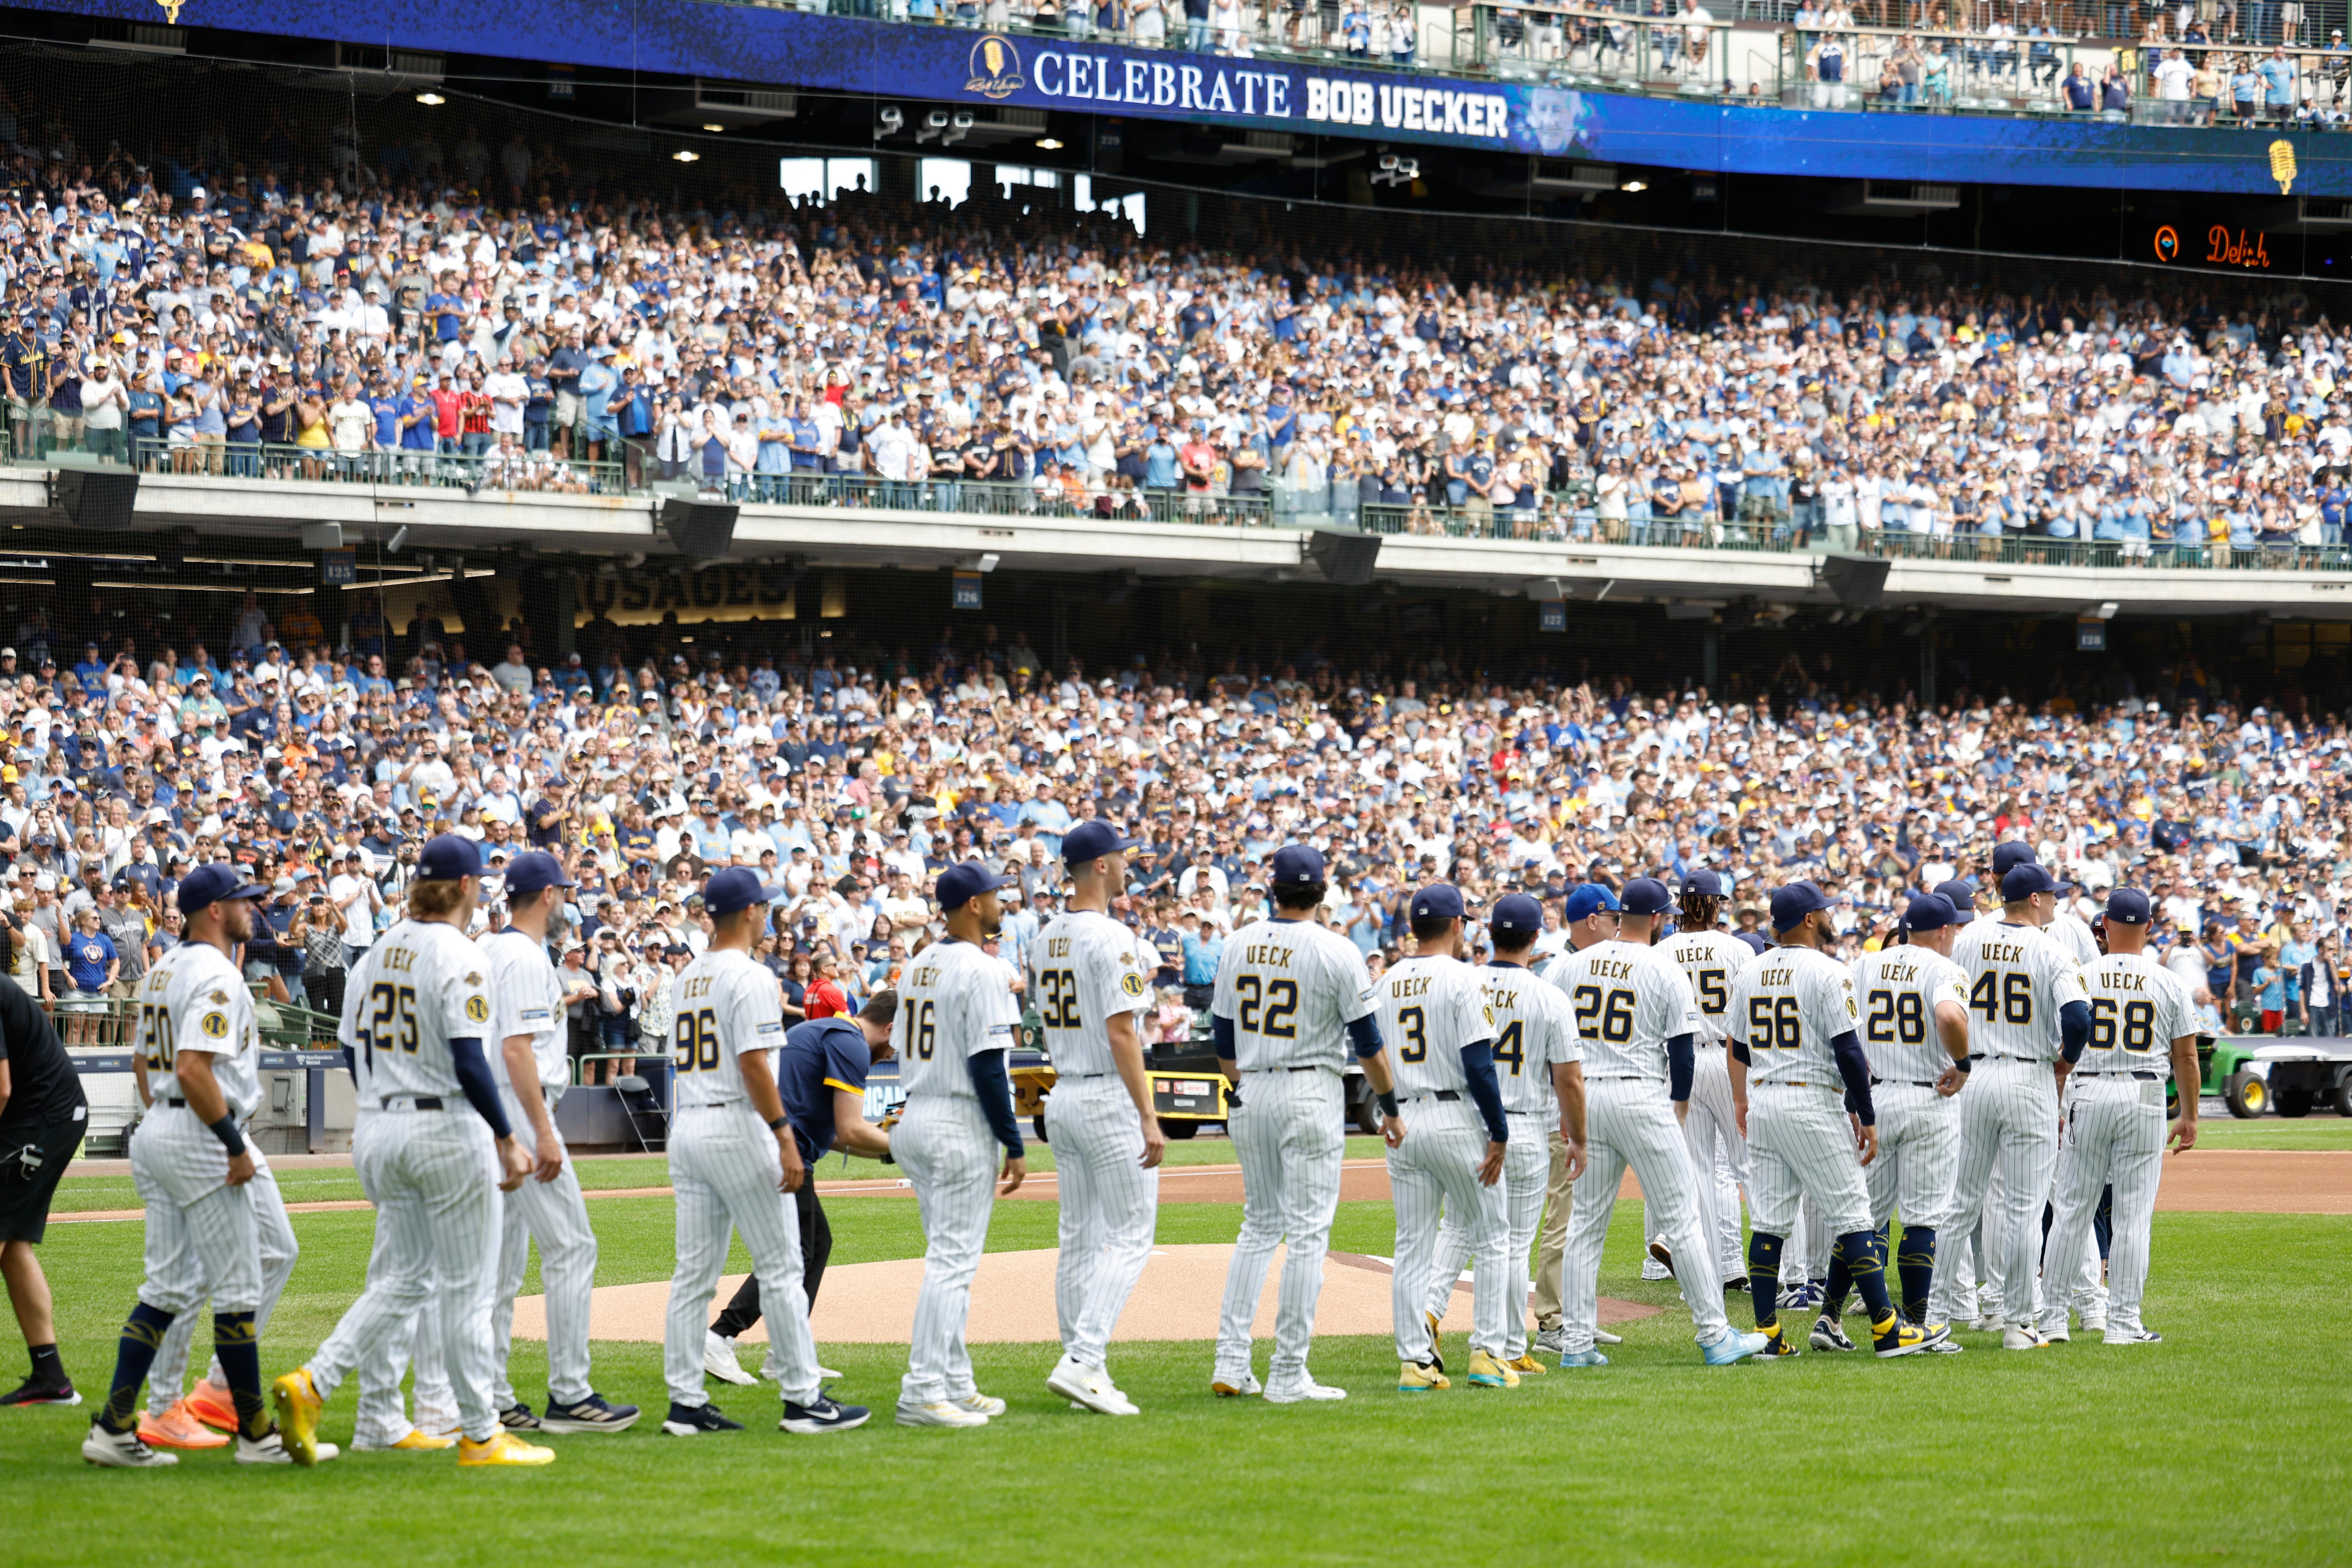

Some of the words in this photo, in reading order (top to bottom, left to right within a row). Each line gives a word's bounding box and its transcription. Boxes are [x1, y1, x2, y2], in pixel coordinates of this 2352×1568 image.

[551, 83, 573, 94] 228
[1034, 50, 1292, 117] CELEBRATE
[1307, 78, 1374, 125] BOB
[1380, 86, 1508, 138] UECKER
[39, 361, 44, 372] 9
[328, 566, 351, 579] 125
[957, 591, 978, 603] 126
[383, 947, 418, 973] UECK
[1247, 945, 1293, 969] UECK
[1675, 946, 1715, 963] UECK
[1982, 943, 2024, 963] UECK
[1590, 959, 1634, 981] UECK
[1761, 968, 1794, 987] UECK
[1881, 963, 1918, 983] UECK
[2100, 972, 2146, 991] UECK
[684, 976, 714, 999] UECK
[1040, 968, 1082, 1029] 32
[1392, 977, 1432, 998] UECK
[1969, 969, 2033, 1026] 46
[371, 982, 419, 1055] 25
[1236, 974, 1299, 1040] 22
[1573, 984, 1637, 1045] 26
[1867, 988, 1927, 1045] 28
[904, 996, 936, 1061] 16
[1398, 1004, 1427, 1064] 3
[1749, 995, 1801, 1050] 56
[2087, 996, 2156, 1053] 68
[143, 1003, 173, 1073] 20
[675, 1007, 720, 1073] 96
